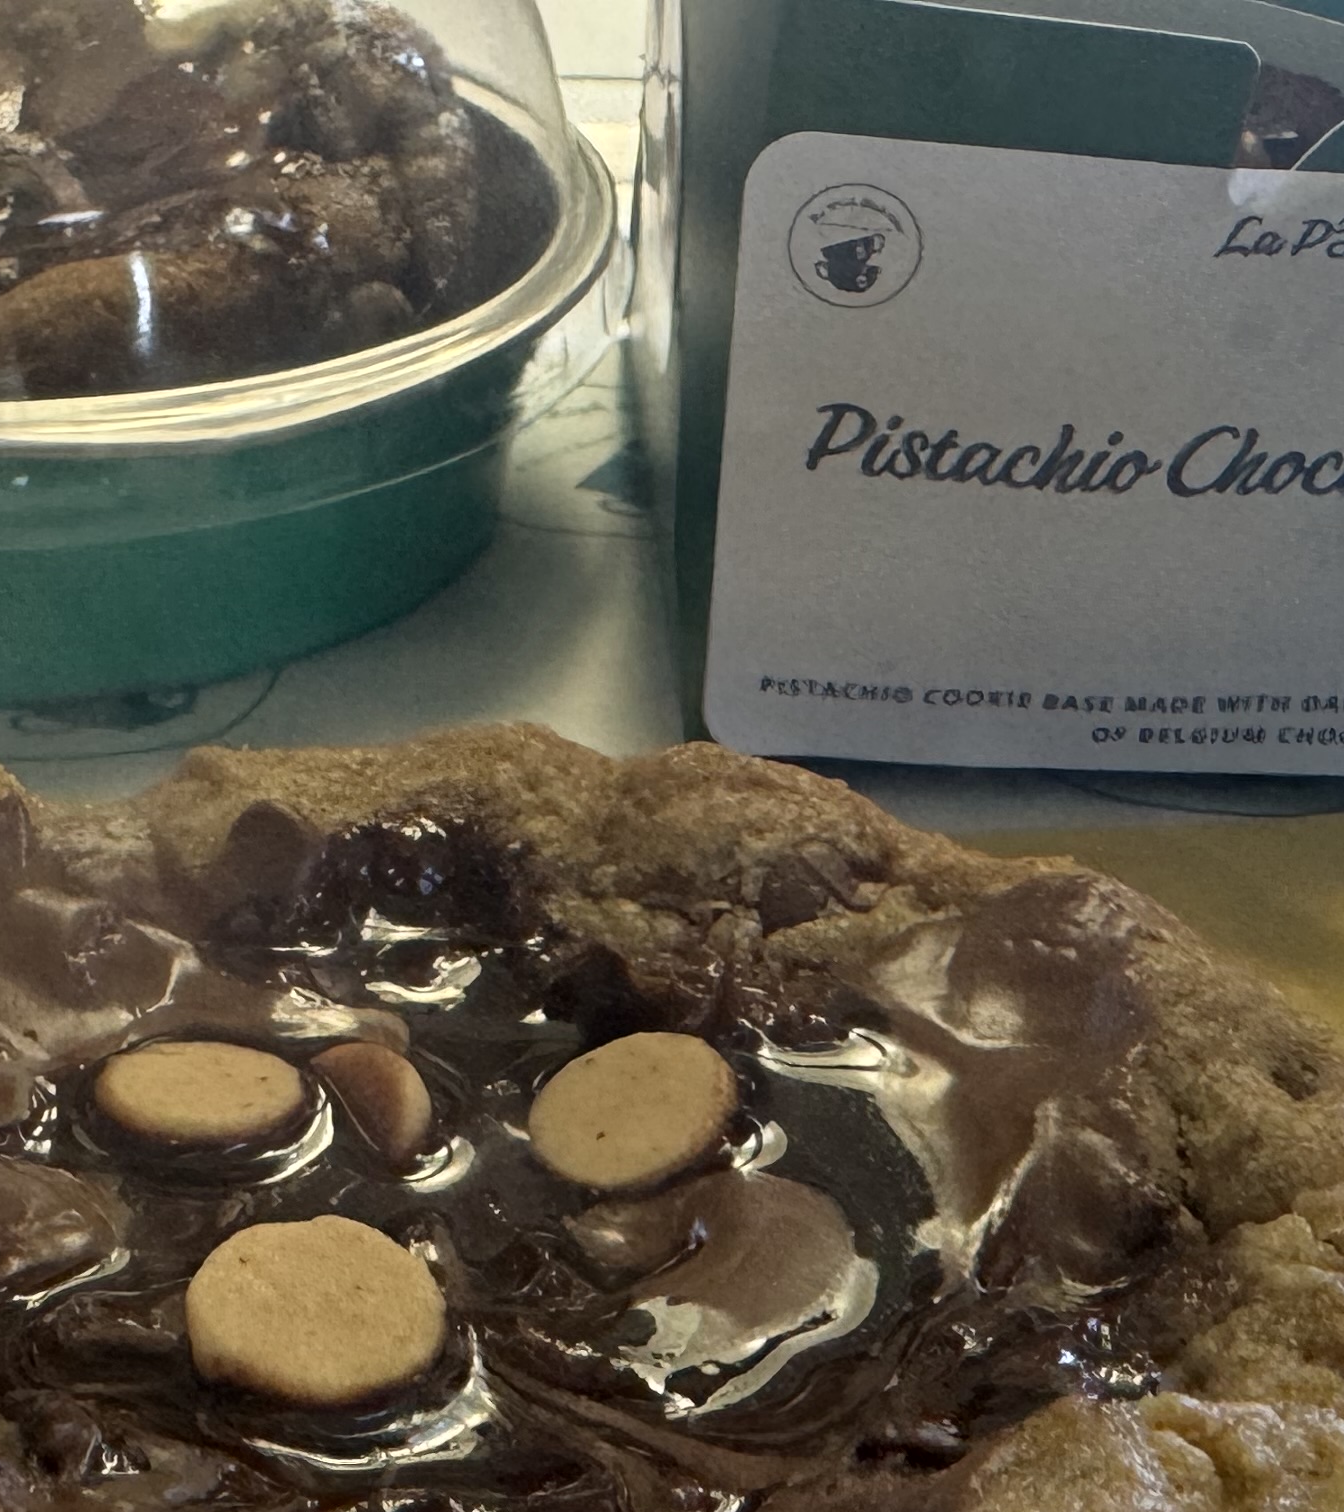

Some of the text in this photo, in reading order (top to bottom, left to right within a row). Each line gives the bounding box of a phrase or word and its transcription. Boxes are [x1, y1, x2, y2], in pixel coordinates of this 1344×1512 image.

[1212, 215, 1288, 258] La
[805, 401, 1162, 495] Pistachio
[759, 674, 914, 704] PISTACHIO
[922, 687, 1033, 710] COOKIE
[1041, 693, 1115, 714] BASE
[1123, 694, 1207, 714] MADE
[1216, 693, 1293, 714] WITH
[1091, 725, 1127, 746] OF
